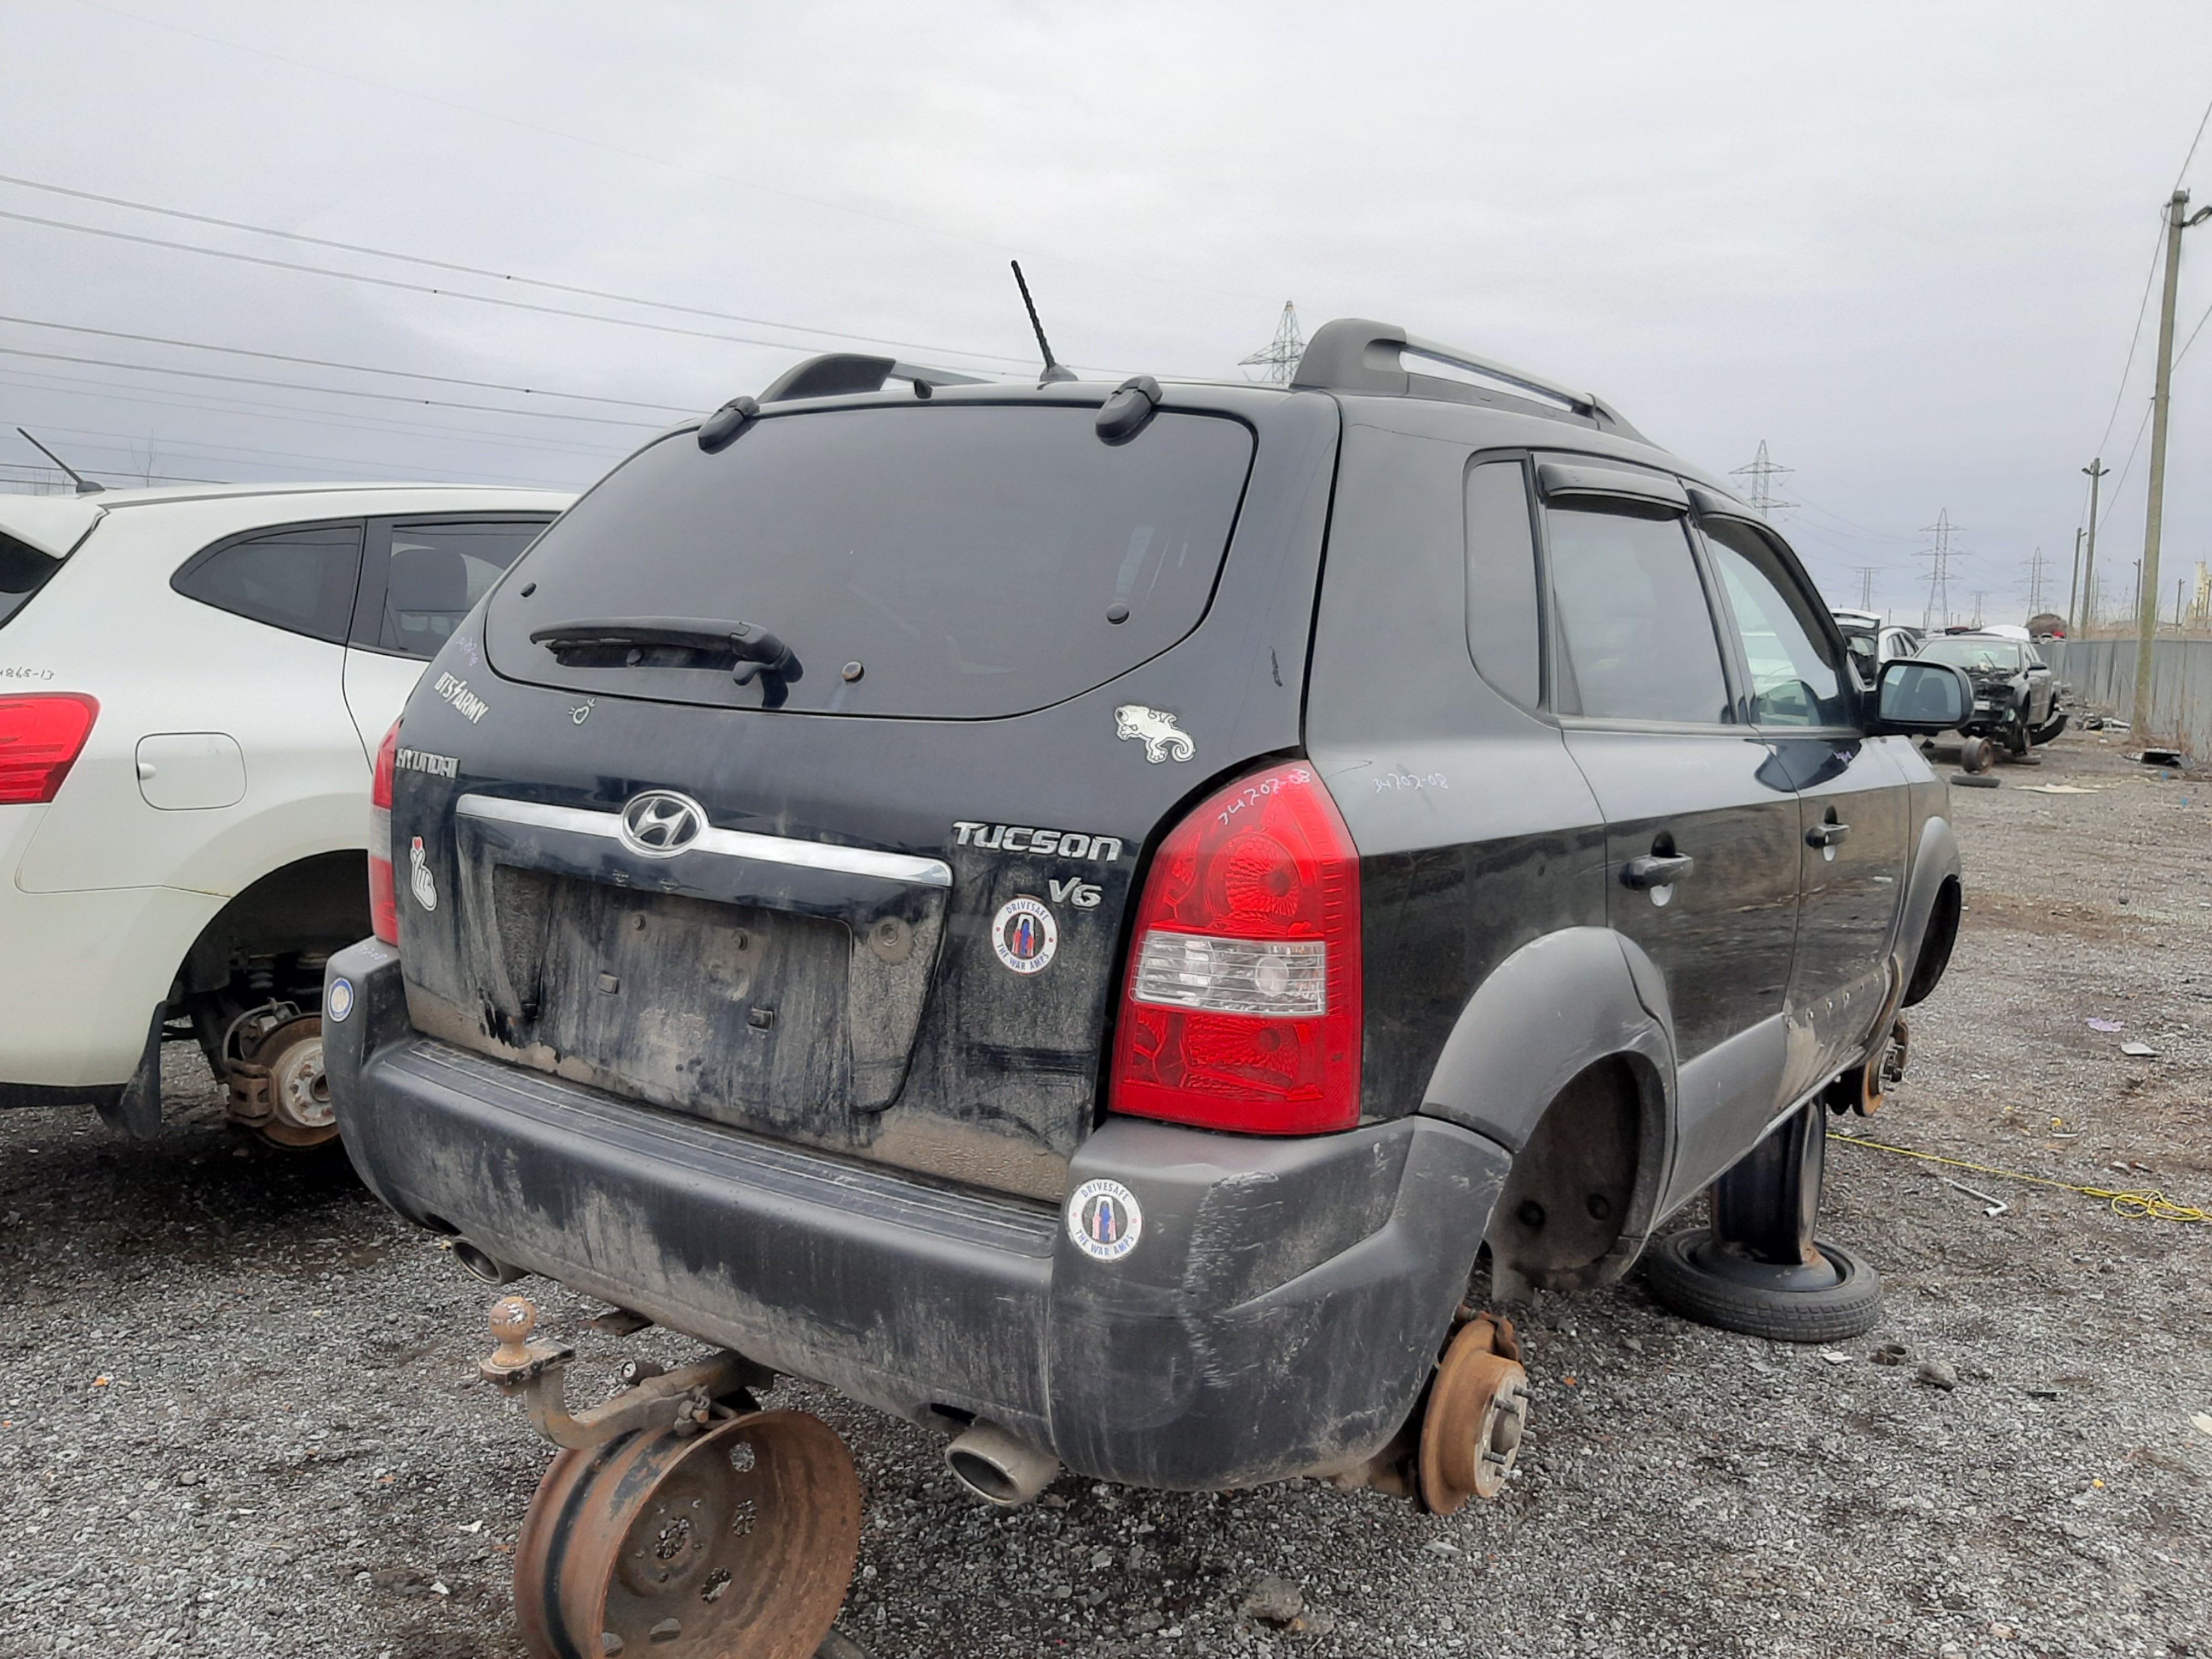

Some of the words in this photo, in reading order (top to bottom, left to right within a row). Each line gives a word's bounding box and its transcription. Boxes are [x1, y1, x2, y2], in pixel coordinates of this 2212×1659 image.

[434, 671, 460, 698] BTS
[451, 688, 490, 724] ARMY
[396, 748, 460, 779] HYUNDAI
[952, 821, 1123, 862] TUCSON
[1048, 877, 1103, 908] V6
[1006, 901, 1049, 921] DRIVESAFE
[997, 943, 1009, 959] THE
[1009, 957, 1026, 970] WAR
[1030, 952, 1049, 971] AMPS
[1081, 1182, 1129, 1202] DRIVESAFE
[1075, 1228, 1089, 1246] THE
[1090, 1243, 1109, 1256] WAR
[1113, 1234, 1135, 1255] AMPS
